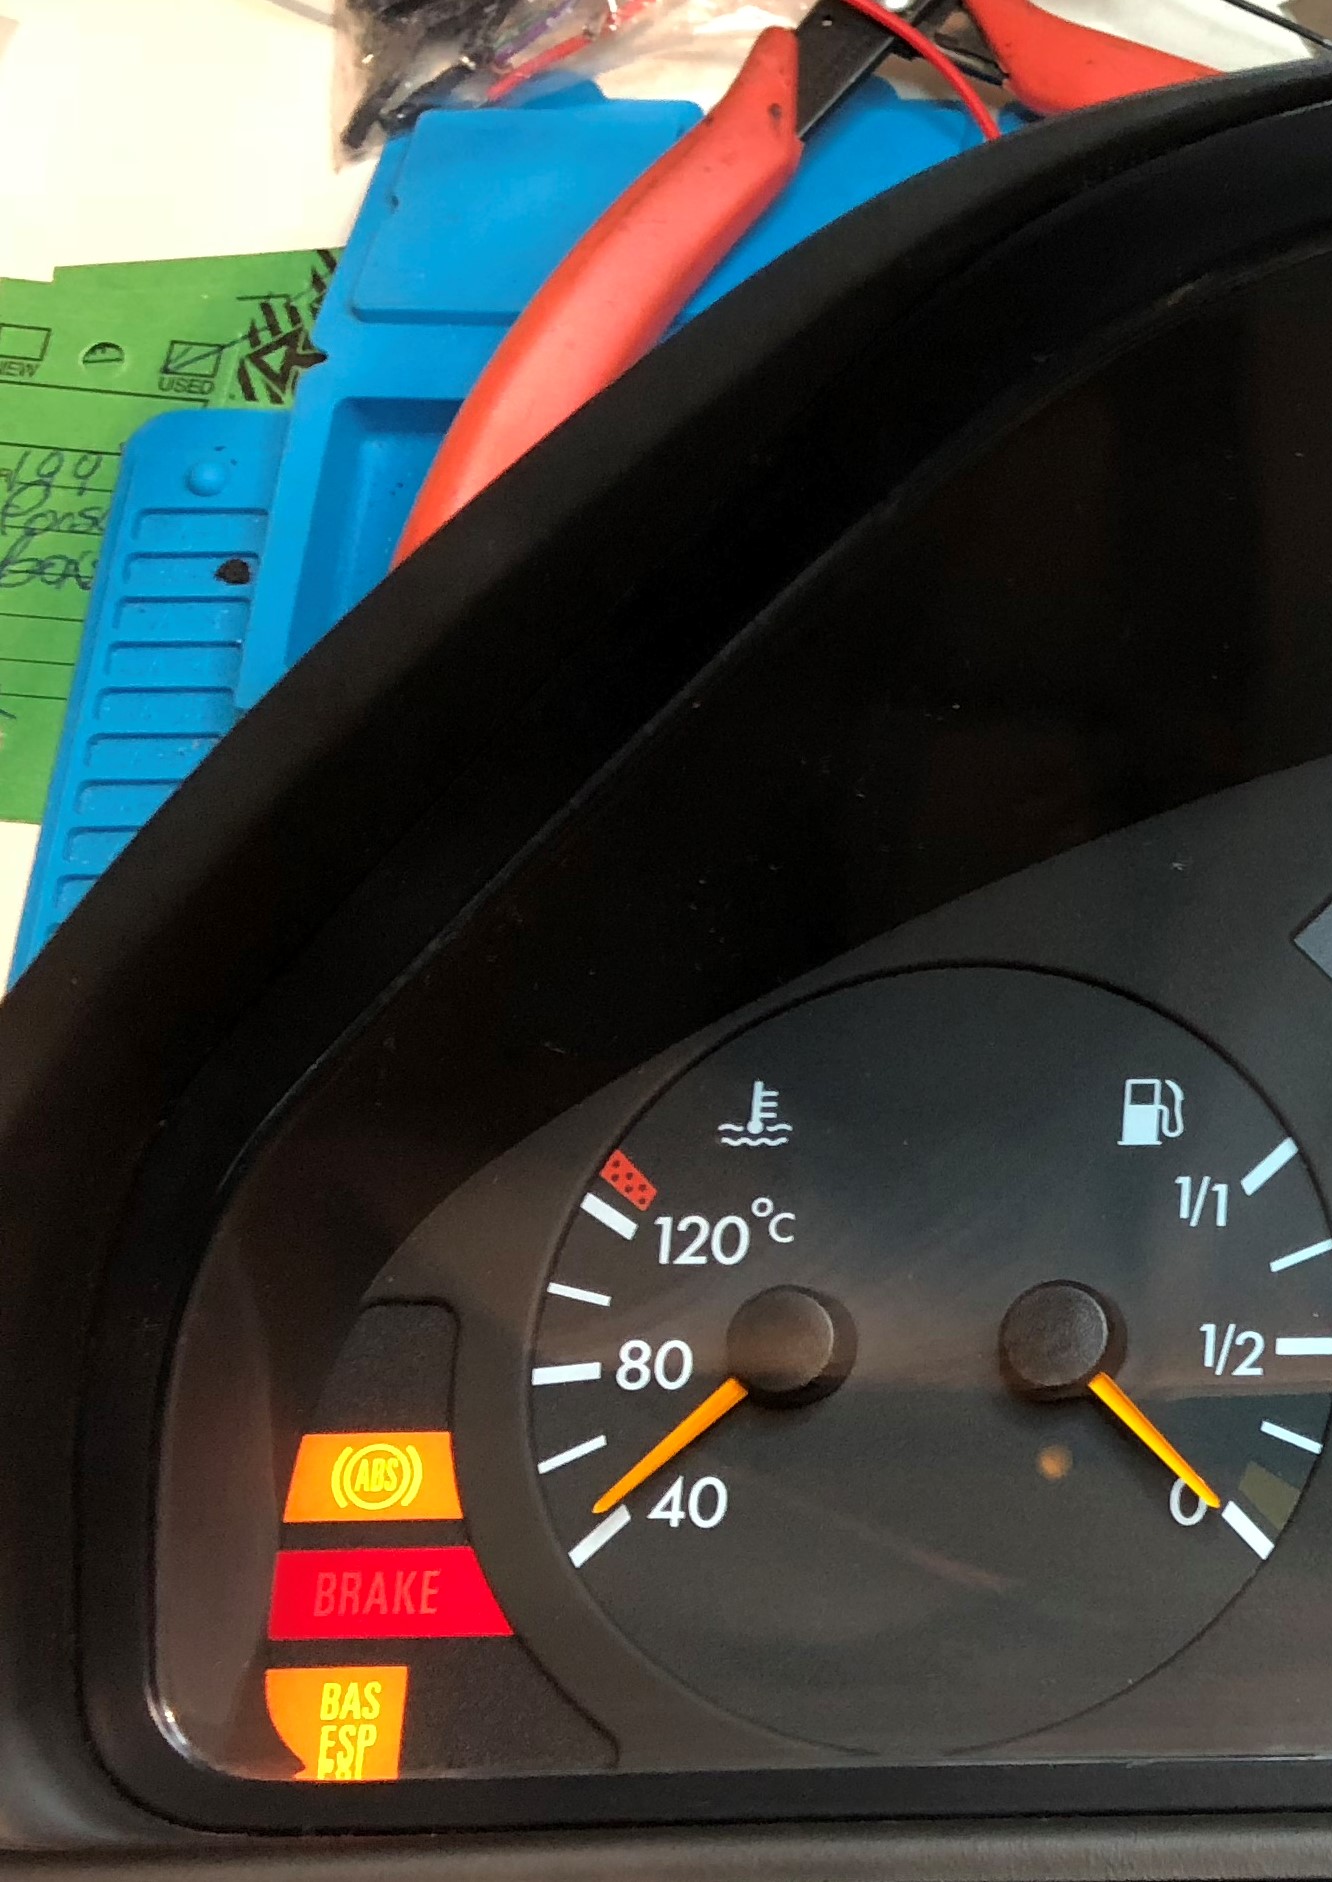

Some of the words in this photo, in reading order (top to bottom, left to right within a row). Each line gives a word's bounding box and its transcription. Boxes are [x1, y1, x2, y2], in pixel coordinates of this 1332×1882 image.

[158, 376, 215, 396] USED
[1175, 1176, 1227, 1227] 1/1
[616, 1340, 692, 1390] 80
[1200, 1324, 1264, 1375] 1/2
[354, 1458, 400, 1492] ABS
[647, 1476, 727, 1528] 40
[1170, 1479, 1207, 1525] 0
[313, 1568, 442, 1617] BRAKE
[319, 1680, 382, 1721] BAS
[318, 1724, 377, 1767] ESP
